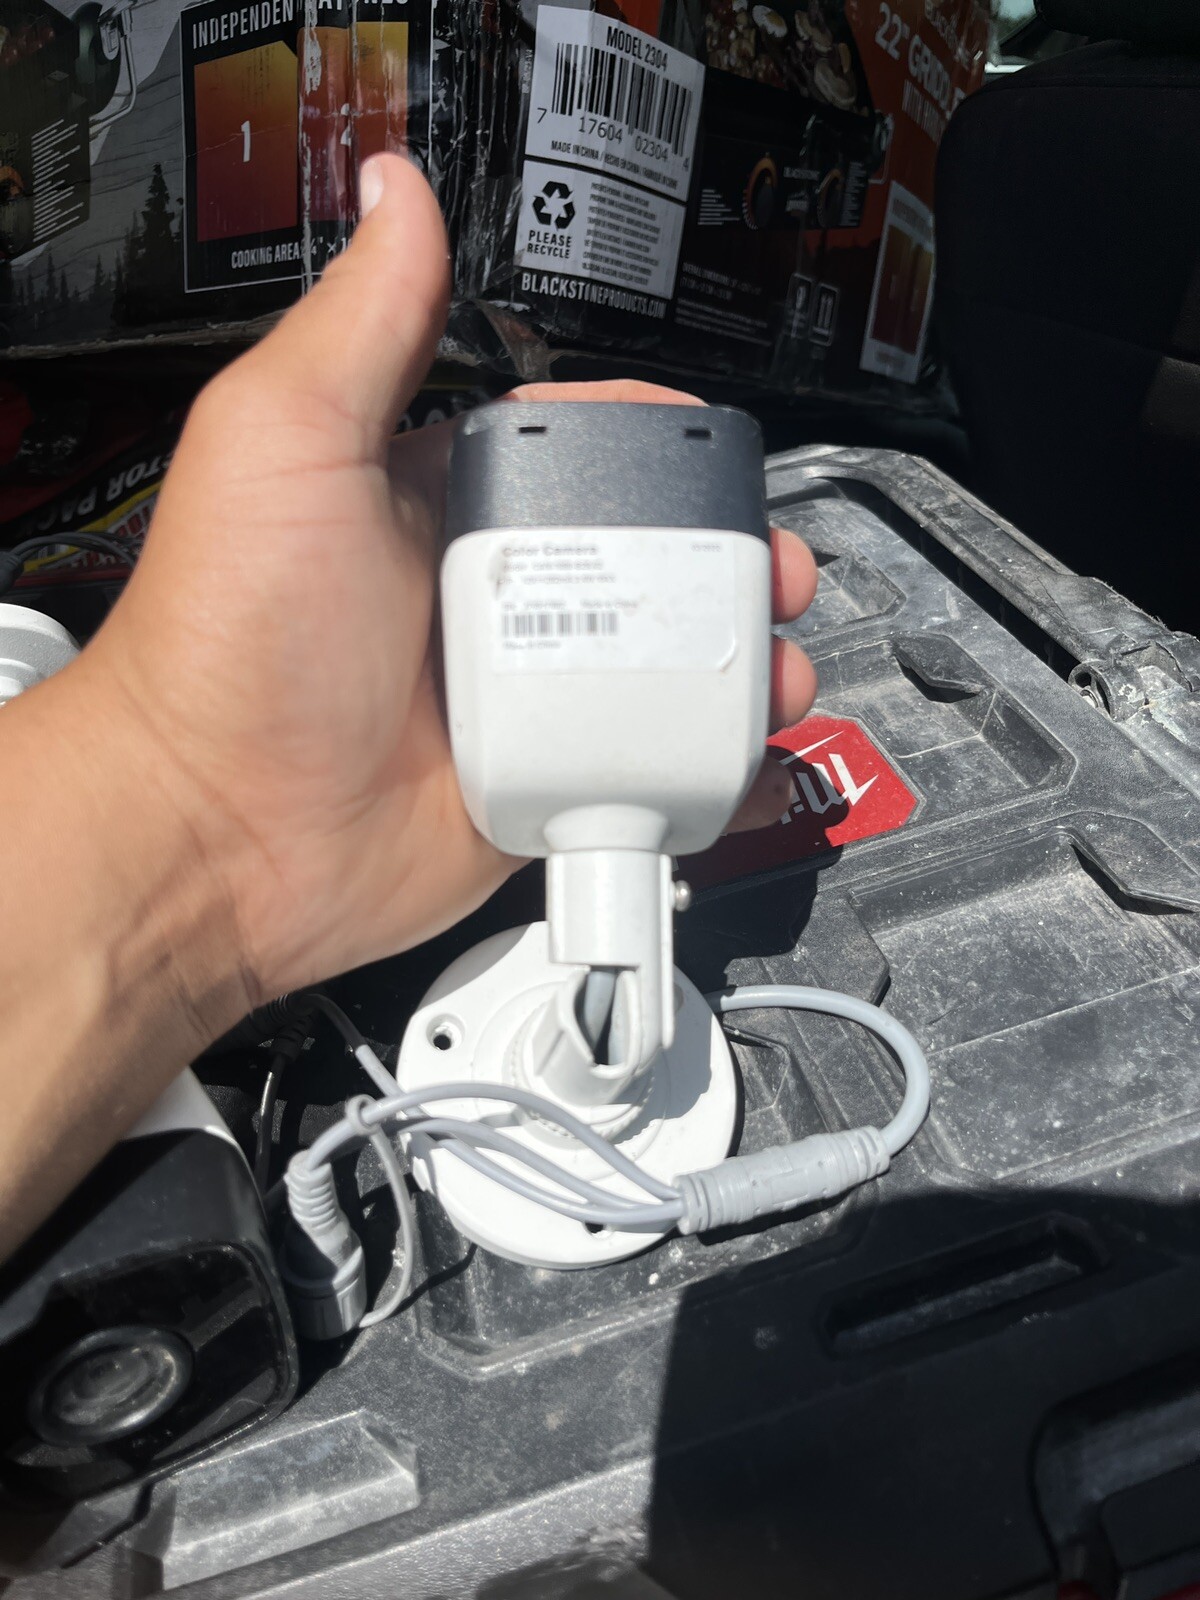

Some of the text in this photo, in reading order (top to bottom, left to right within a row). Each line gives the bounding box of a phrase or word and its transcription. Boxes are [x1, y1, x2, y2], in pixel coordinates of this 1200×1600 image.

[192, 0, 293, 49] INDEPENDEN
[606, 26, 668, 72] MODEL 2304
[240, 120, 251, 163] 1
[537, 107, 548, 124] 7
[578, 116, 623, 144] 17604
[635, 136, 669, 162] 02304
[551, 140, 571, 154] MADE
[231, 246, 273, 269] COOKING
[527, 245, 570, 259] RECYCLE
[528, 230, 572, 248] PLEASE
[107, 453, 172, 501] TOR
